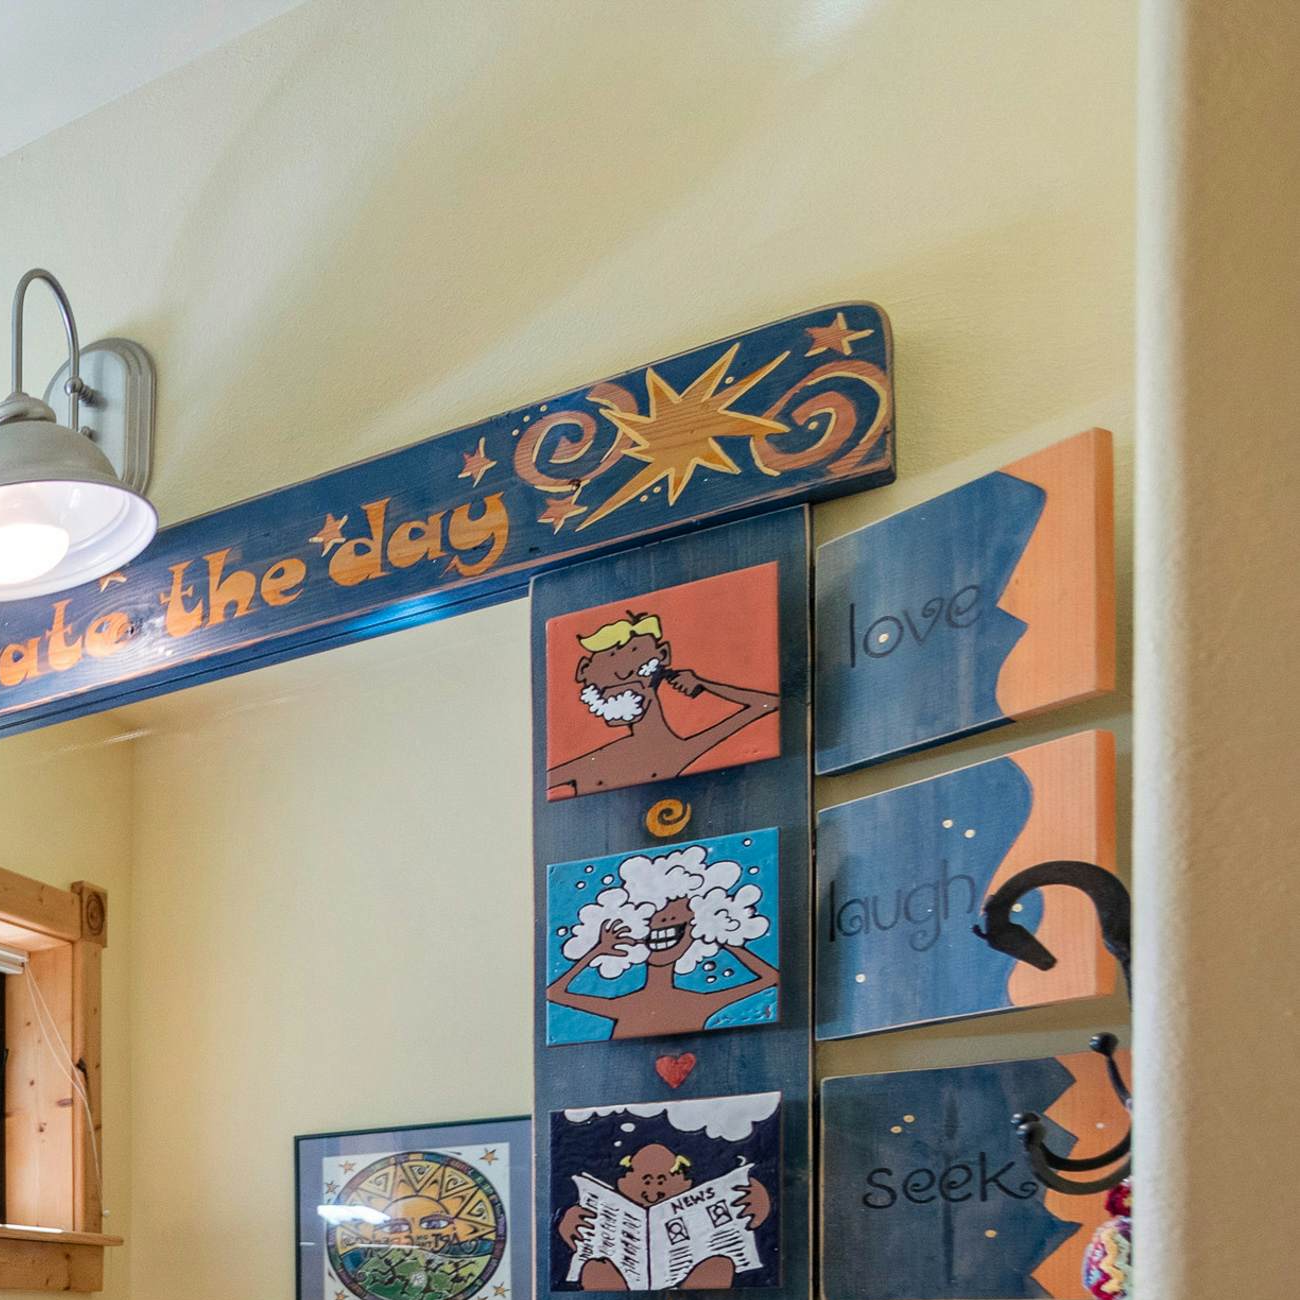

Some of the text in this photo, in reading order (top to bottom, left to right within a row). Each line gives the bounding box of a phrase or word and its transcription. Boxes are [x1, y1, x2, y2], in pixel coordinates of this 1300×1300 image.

[160, 547, 307, 638] the
[328, 492, 510, 587] day
[849, 584, 984, 669] love
[828, 858, 977, 953] laugh
[670, 1187, 716, 1215] NEWS
[861, 1151, 1040, 1210] seek
